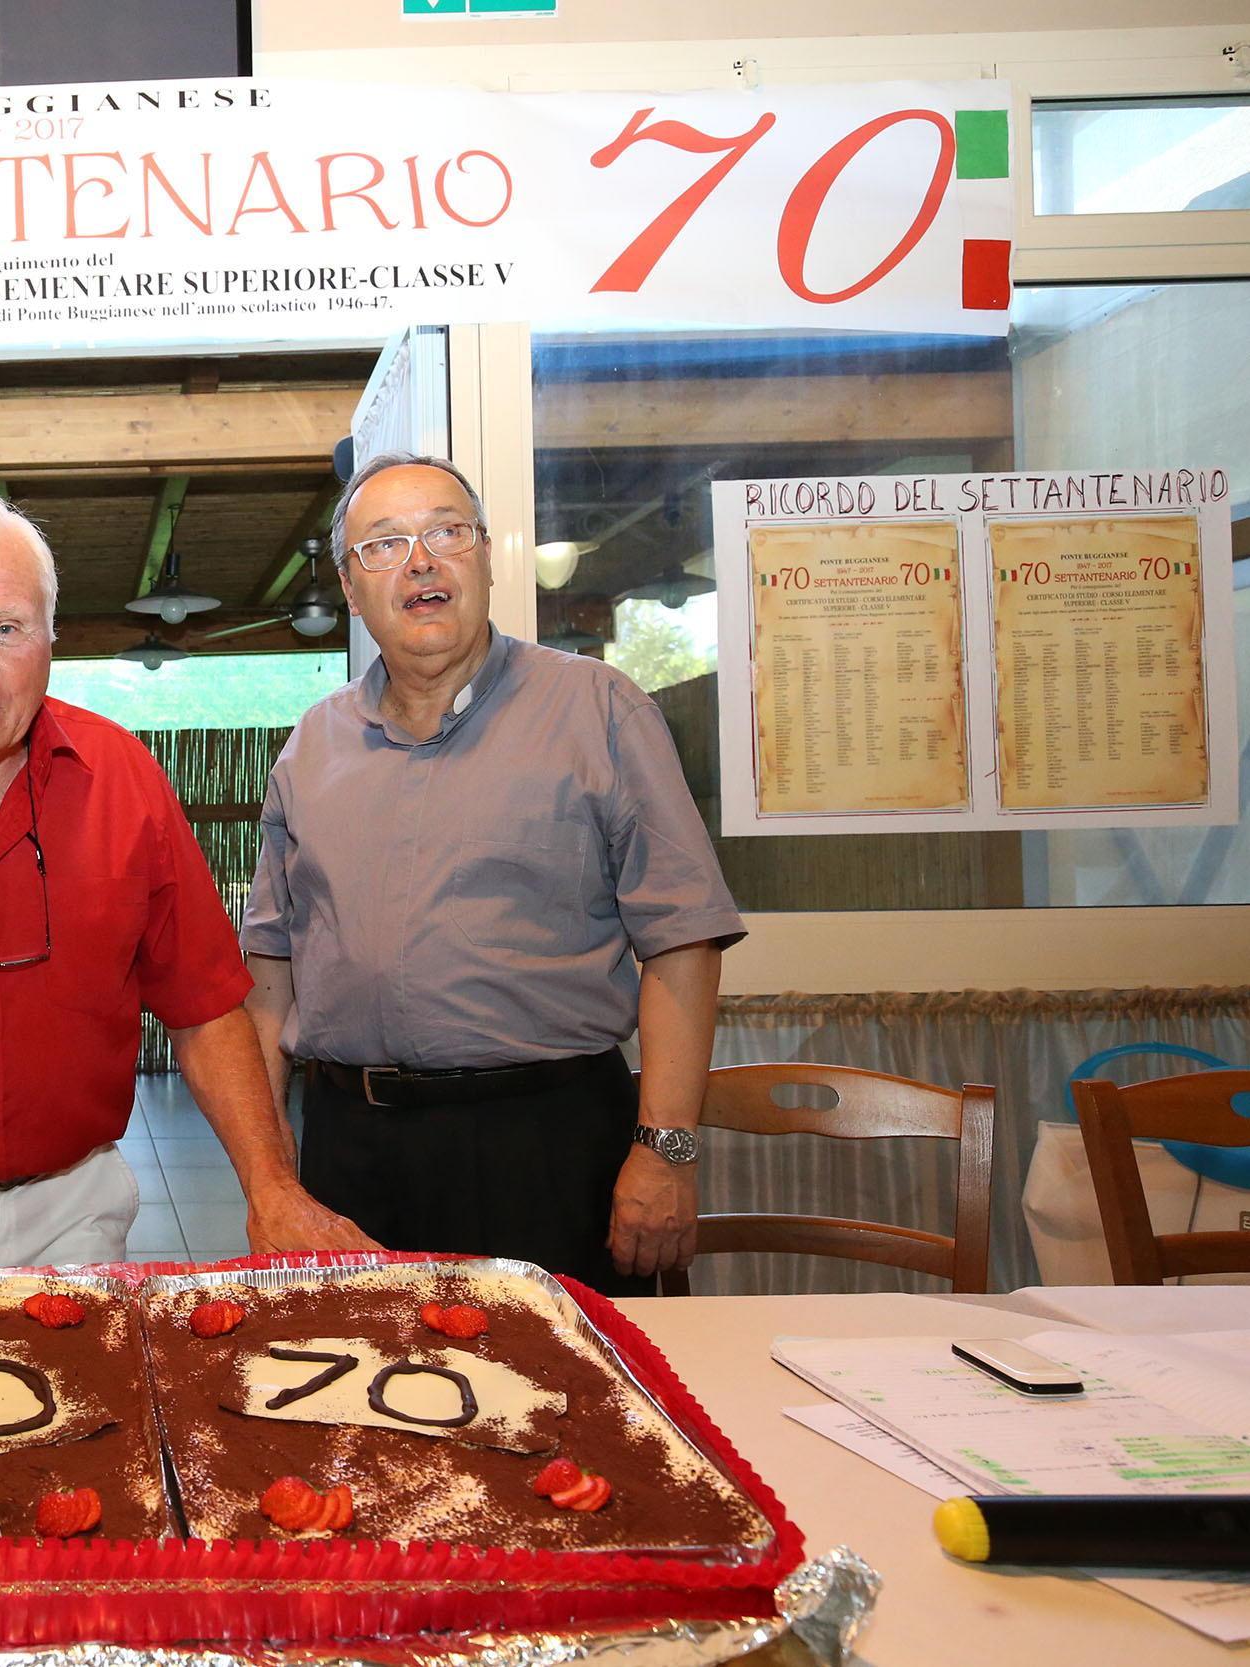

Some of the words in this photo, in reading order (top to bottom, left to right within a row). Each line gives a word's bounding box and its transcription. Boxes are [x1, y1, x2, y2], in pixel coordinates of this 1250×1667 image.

[14, 117, 85, 141] 2017
[588, 107, 956, 305] 70
[86, 252, 115, 268] del
[183, 262, 485, 296] SUPERIORE-CLASSE
[493, 261, 516, 286] V
[17, 306, 63, 322] Ponte
[68, 304, 158, 323] Buggianese
[162, 301, 236, 317] nell'anno
[239, 299, 317, 315] scolastico
[327, 296, 393, 311] 1946-47.
[744, 481, 876, 516] RICORDO
[894, 478, 945, 513] DEL
[956, 468, 1230, 513] SETTANTENARIO
[819, 558, 843, 566] PONTE
[844, 556, 890, 565] BUGGIANESE
[1060, 553, 1083, 561] PONTE
[1084, 552, 1129, 560] BUGGIANESE
[1138, 556, 1171, 581] 70
[779, 566, 810, 591] 70
[813, 575, 899, 589] SETTANTENARIO
[899, 561, 931, 587] 70
[1019, 561, 1051, 586] 70
[1054, 570, 1137, 583] SETTANTENARIO
[265, 1346, 479, 1429] 70
